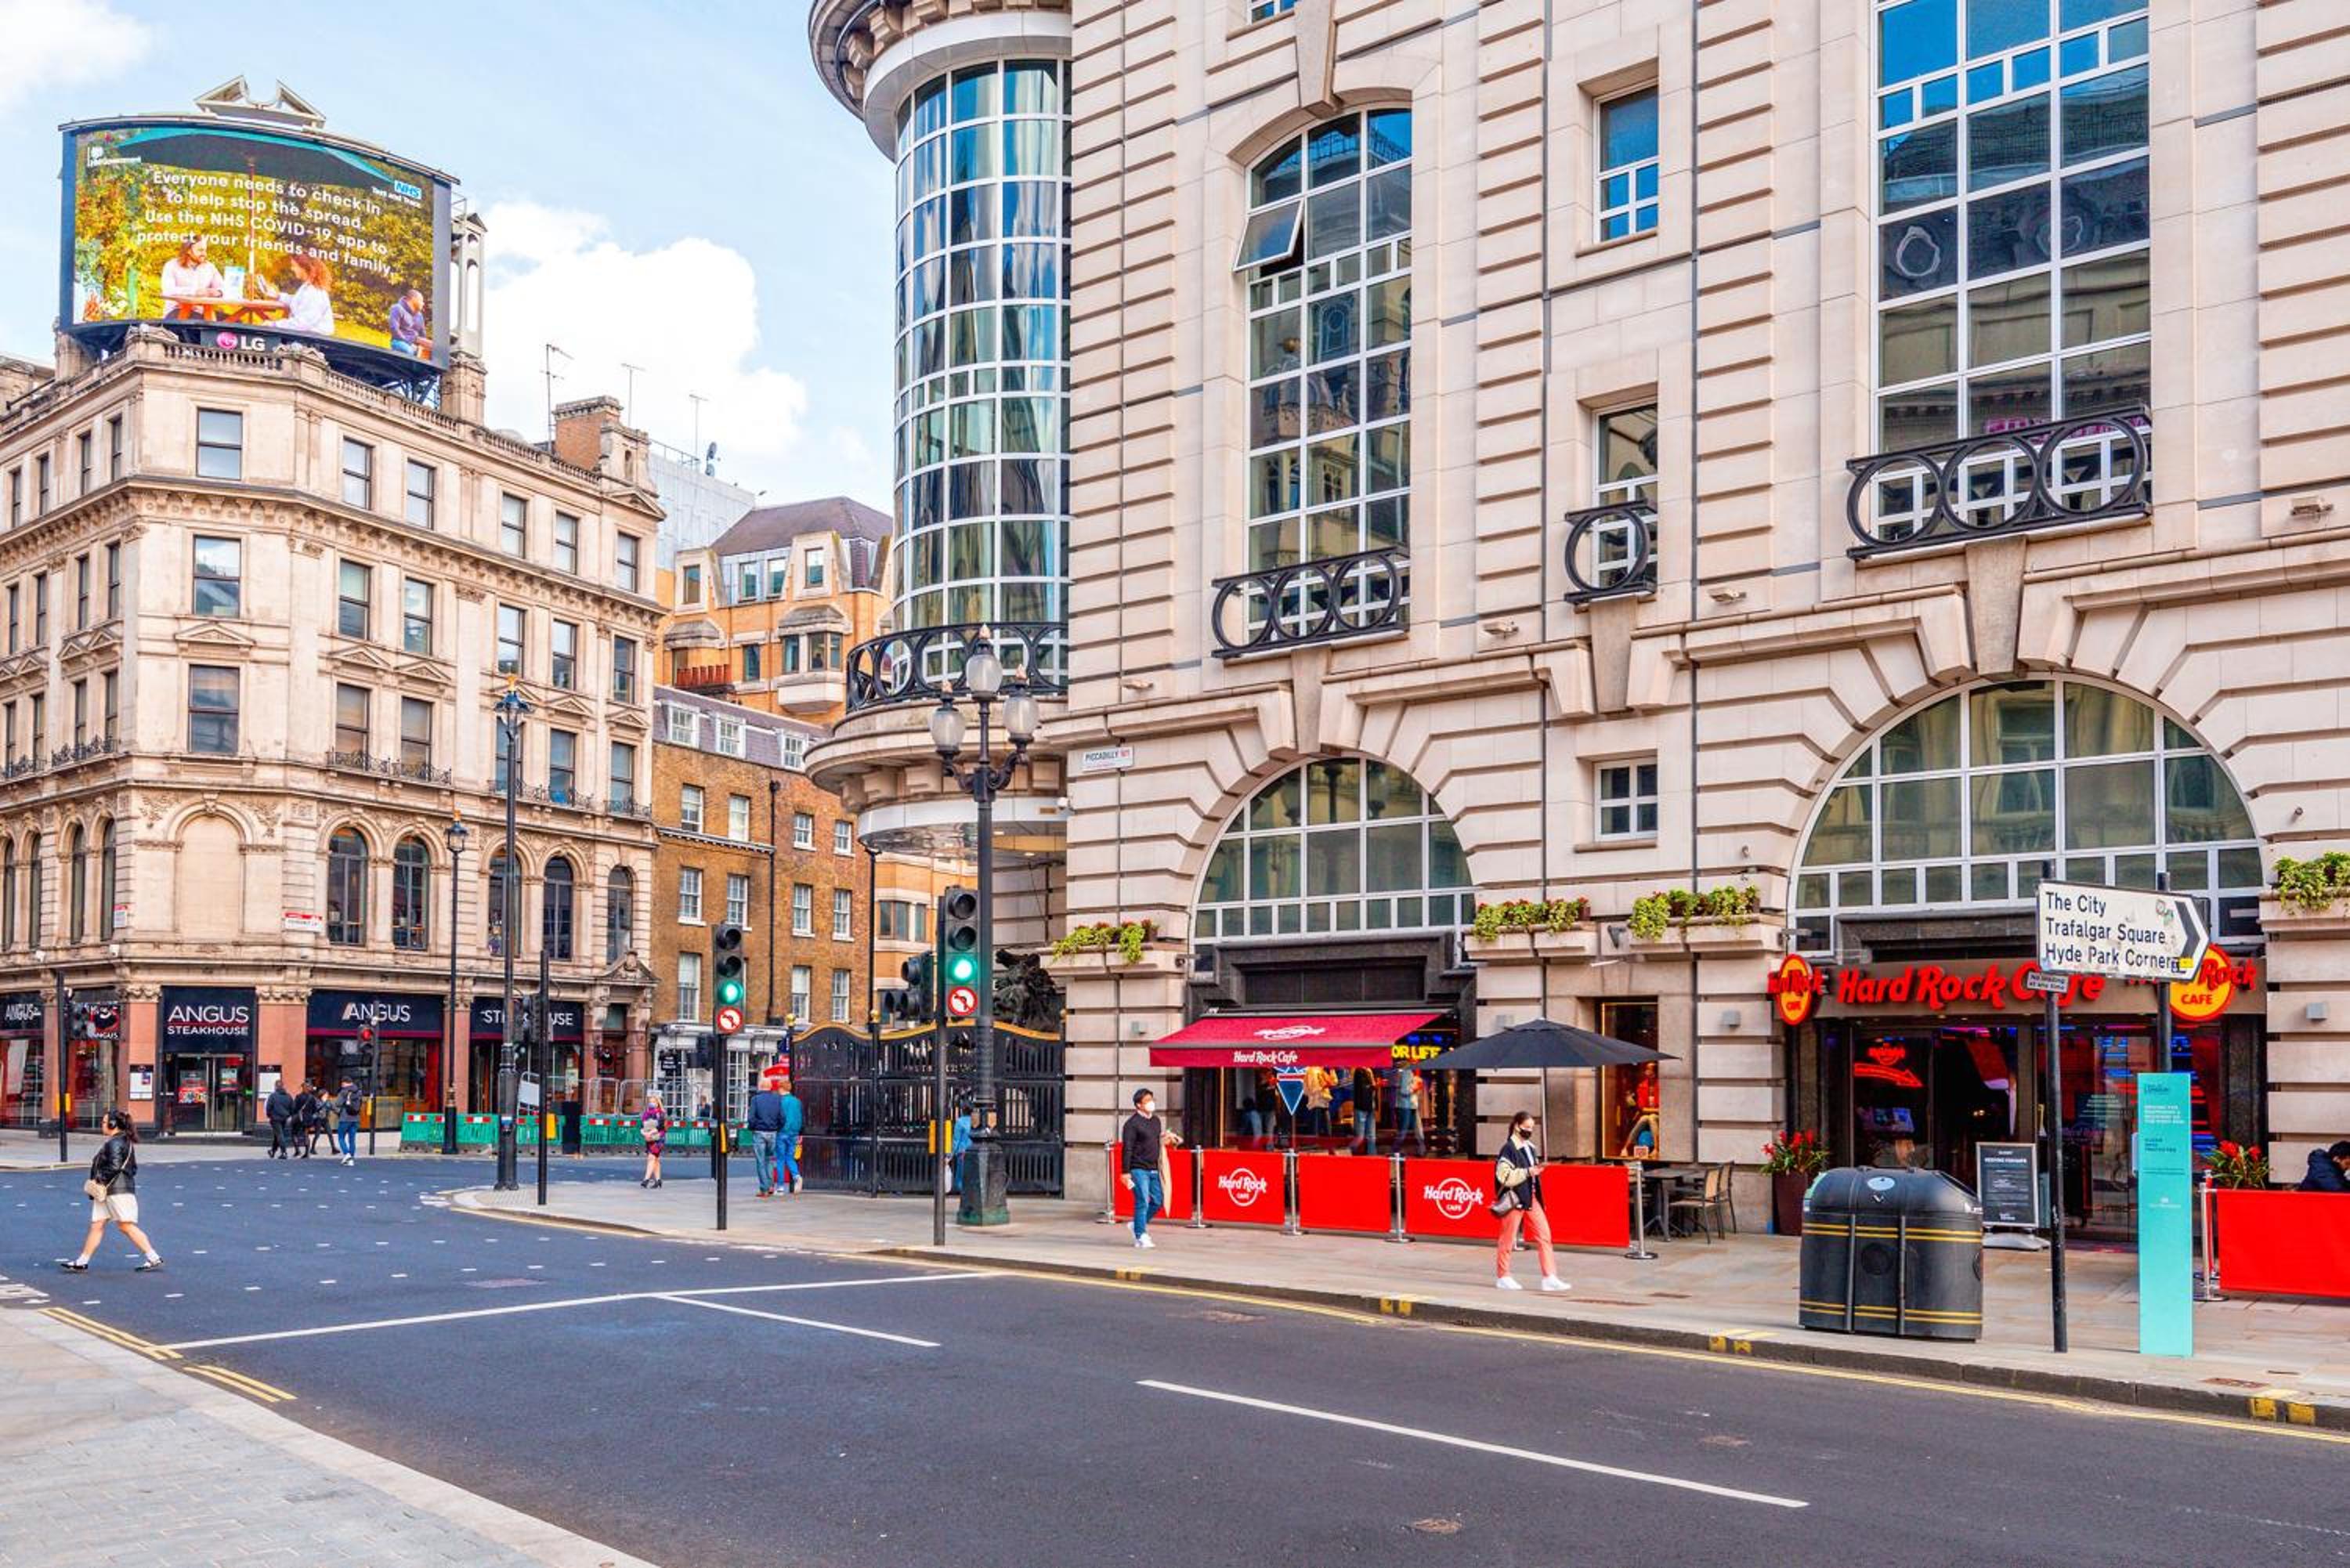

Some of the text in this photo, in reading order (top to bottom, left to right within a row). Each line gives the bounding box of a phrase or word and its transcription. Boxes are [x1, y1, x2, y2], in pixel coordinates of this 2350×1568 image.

[154, 172, 381, 215] Everyone needs to check in
[396, 182, 420, 198] NHS
[189, 192, 224, 209] help
[230, 196, 266, 213] stop
[273, 201, 299, 216] the
[305, 208, 366, 230] spread.
[145, 210, 388, 255] Use the NHS COVID-19 app to
[137, 231, 195, 245] protect
[201, 235, 238, 247] your
[244, 235, 302, 255] friends
[308, 247, 339, 262] and
[240, 335, 266, 351] LG
[1086, 750, 1118, 761] PICCADILLY
[2045, 892, 2106, 917] The City
[2045, 918, 2166, 945] Trafalgar Square
[2045, 943, 2171, 968] Hyde Park Corner
[2199, 957, 2257, 991] Rock
[1836, 960, 2106, 1010] Hard Rock Cfe
[2181, 994, 2213, 1005] CAFE
[5, 1003, 34, 1020] ANGUS
[168, 1005, 249, 1023] ANGUS
[342, 1003, 410, 1022] ANGUS
[168, 1026, 248, 1035] STEAKHOUSE
[1234, 1050, 1298, 1064] Hard Rock Cafe
[1218, 1175, 1267, 1194] Hard Rock
[1424, 1185, 1484, 1205] Hard Rock
